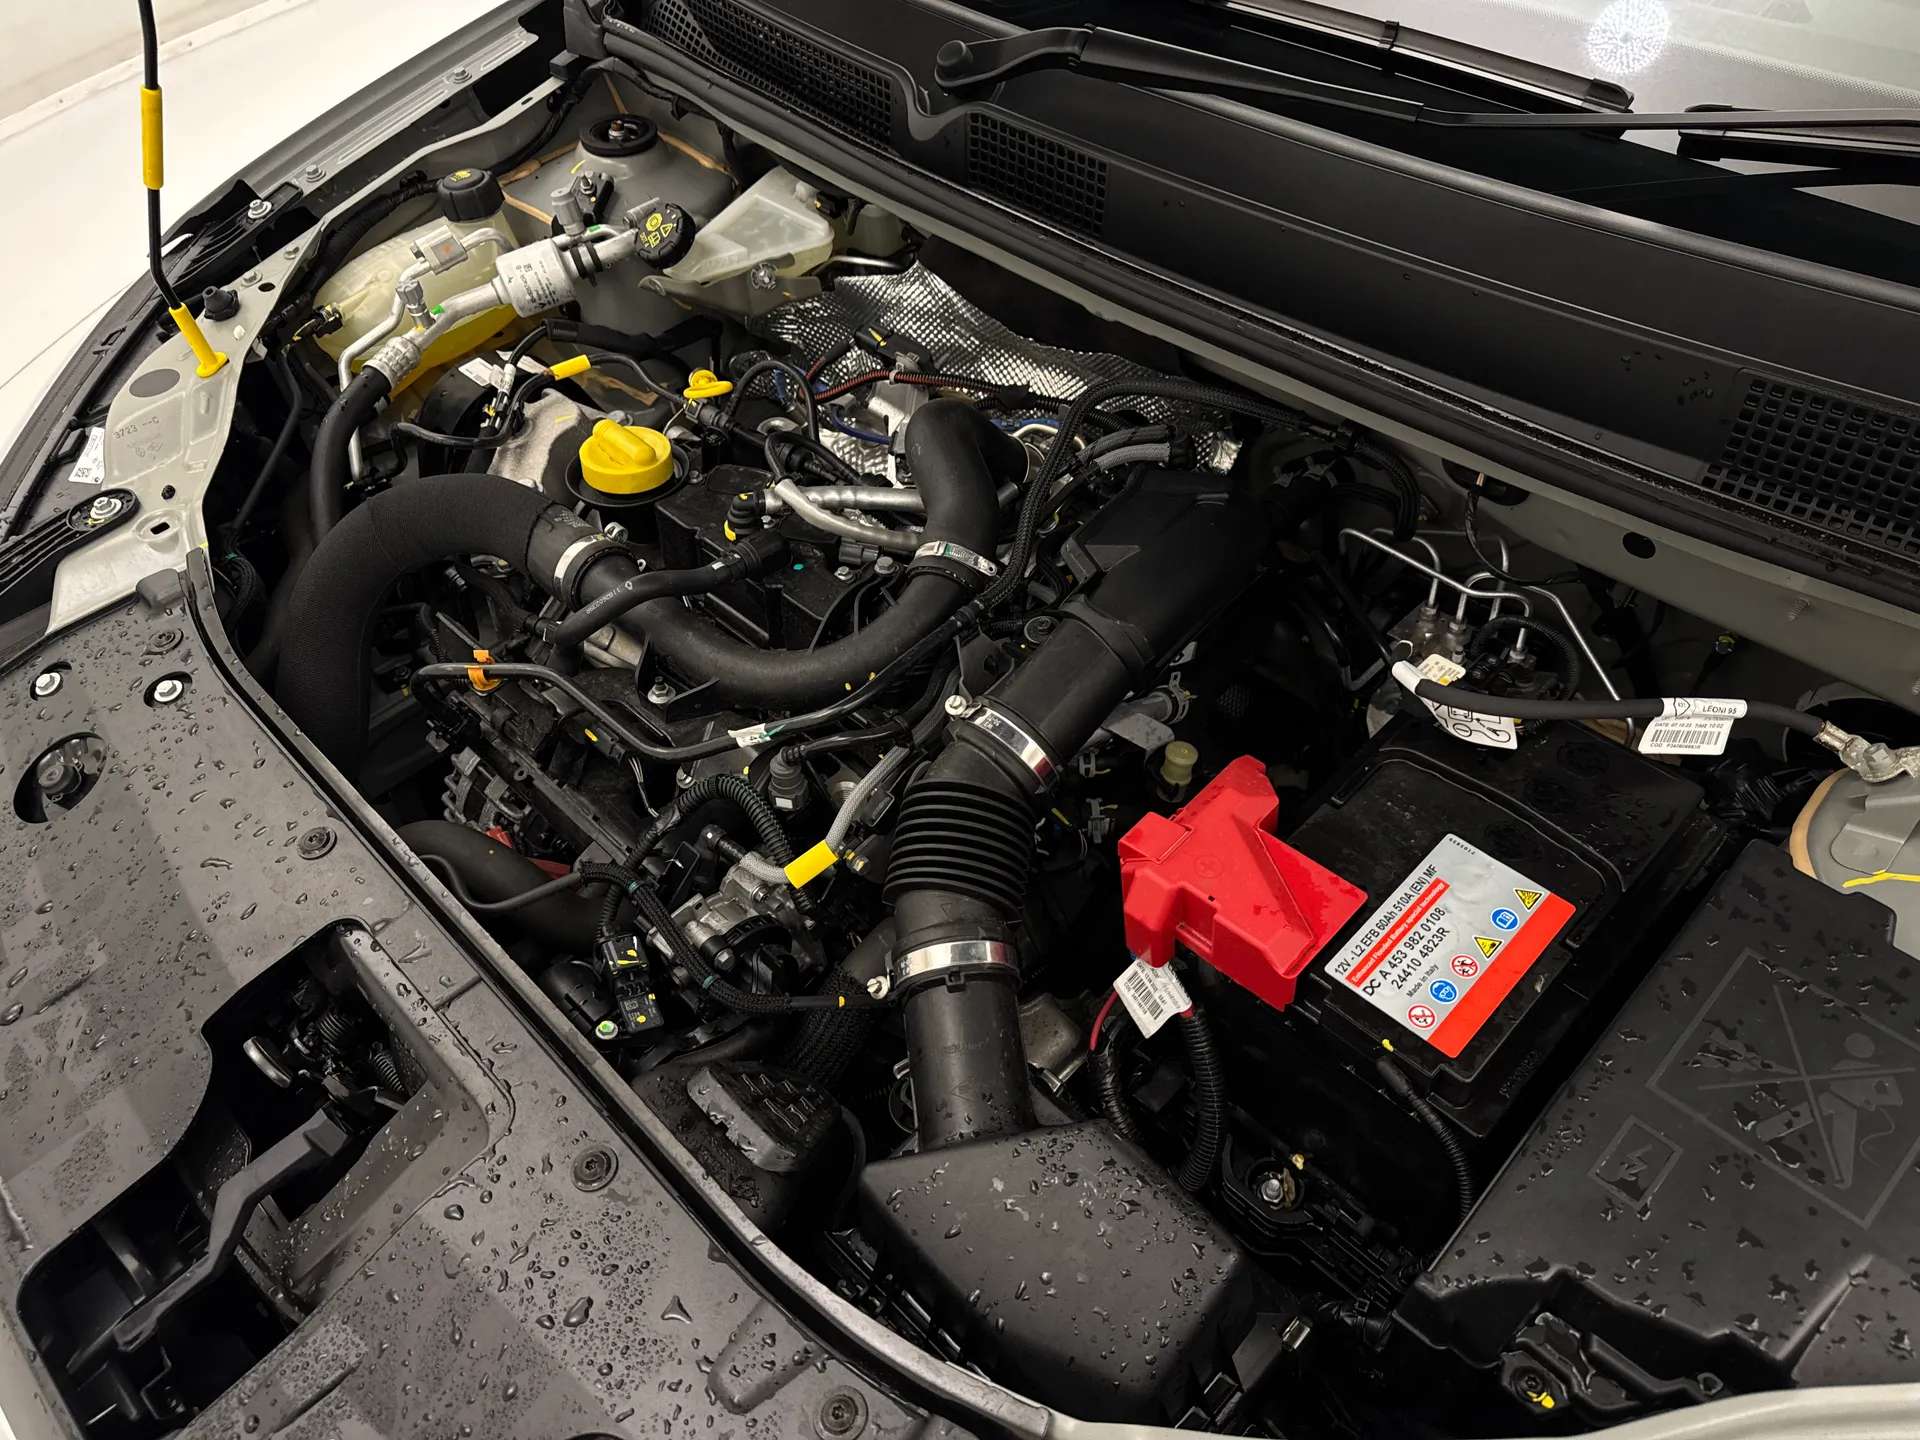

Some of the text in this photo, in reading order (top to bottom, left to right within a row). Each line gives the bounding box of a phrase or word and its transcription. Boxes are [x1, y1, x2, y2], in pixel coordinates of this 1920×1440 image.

[1702, 704, 1726, 714] LEONI
[1334, 958, 1351, 975] 12V
[1351, 944, 1366, 957] L2
[1360, 928, 1380, 947] EFB
[1375, 911, 1397, 931] 60Ah
[1393, 893, 1414, 912] 510A
[1409, 876, 1430, 895] (EN)
[1423, 864, 1437, 878] MF
[1351, 882, 1445, 982] Enhanced Flooded Battery special technology
[1379, 970, 1391, 980] A
[1388, 950, 1407, 968] 453
[1404, 931, 1425, 951] 982
[1420, 907, 1446, 932] 0108
[1391, 927, 1451, 989] 24410 4823R
[1407, 964, 1439, 997] Made in Italy
